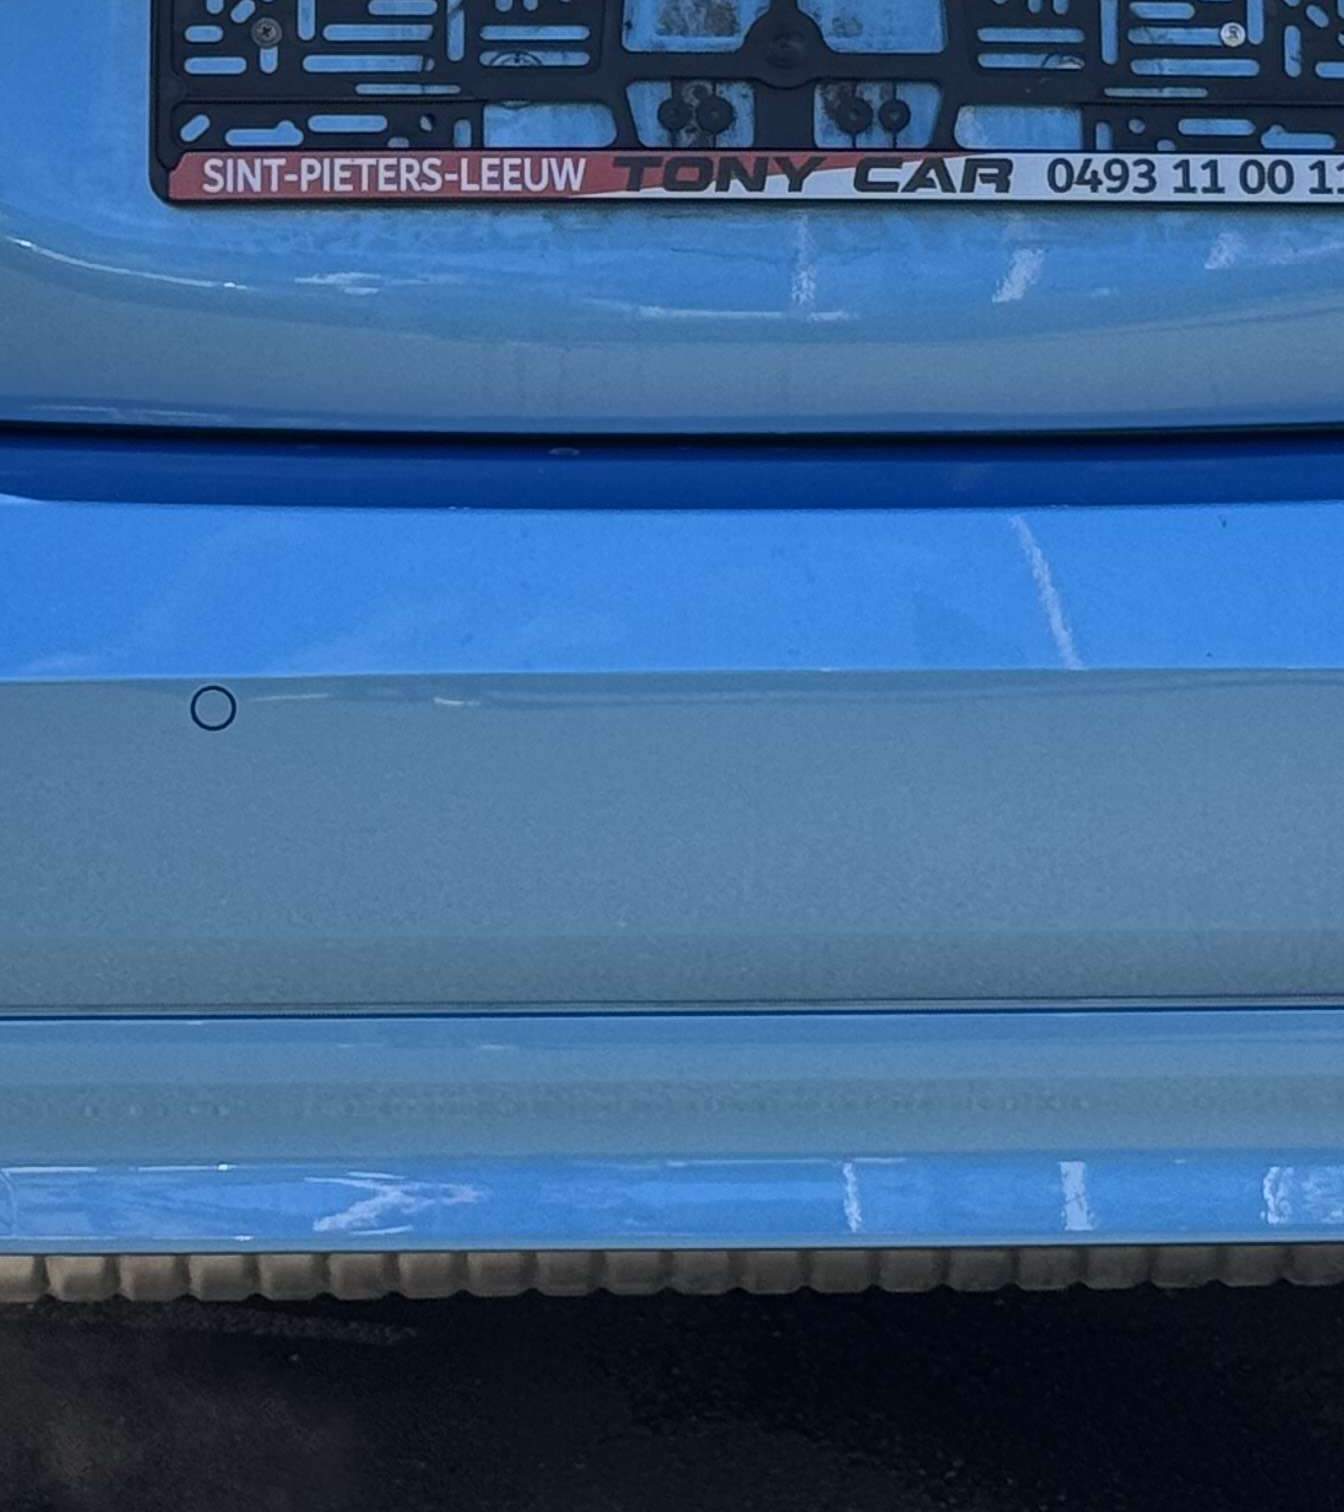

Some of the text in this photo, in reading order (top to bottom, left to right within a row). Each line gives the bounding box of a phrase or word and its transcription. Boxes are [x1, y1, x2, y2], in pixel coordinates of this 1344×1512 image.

[202, 157, 587, 193] SINT-PIETERS-LEEUW
[612, 156, 826, 194] TONY
[853, 156, 1015, 194] CAR
[1046, 157, 1157, 195] 0493
[1171, 159, 1226, 195] 11
[1238, 159, 1295, 195] 00
